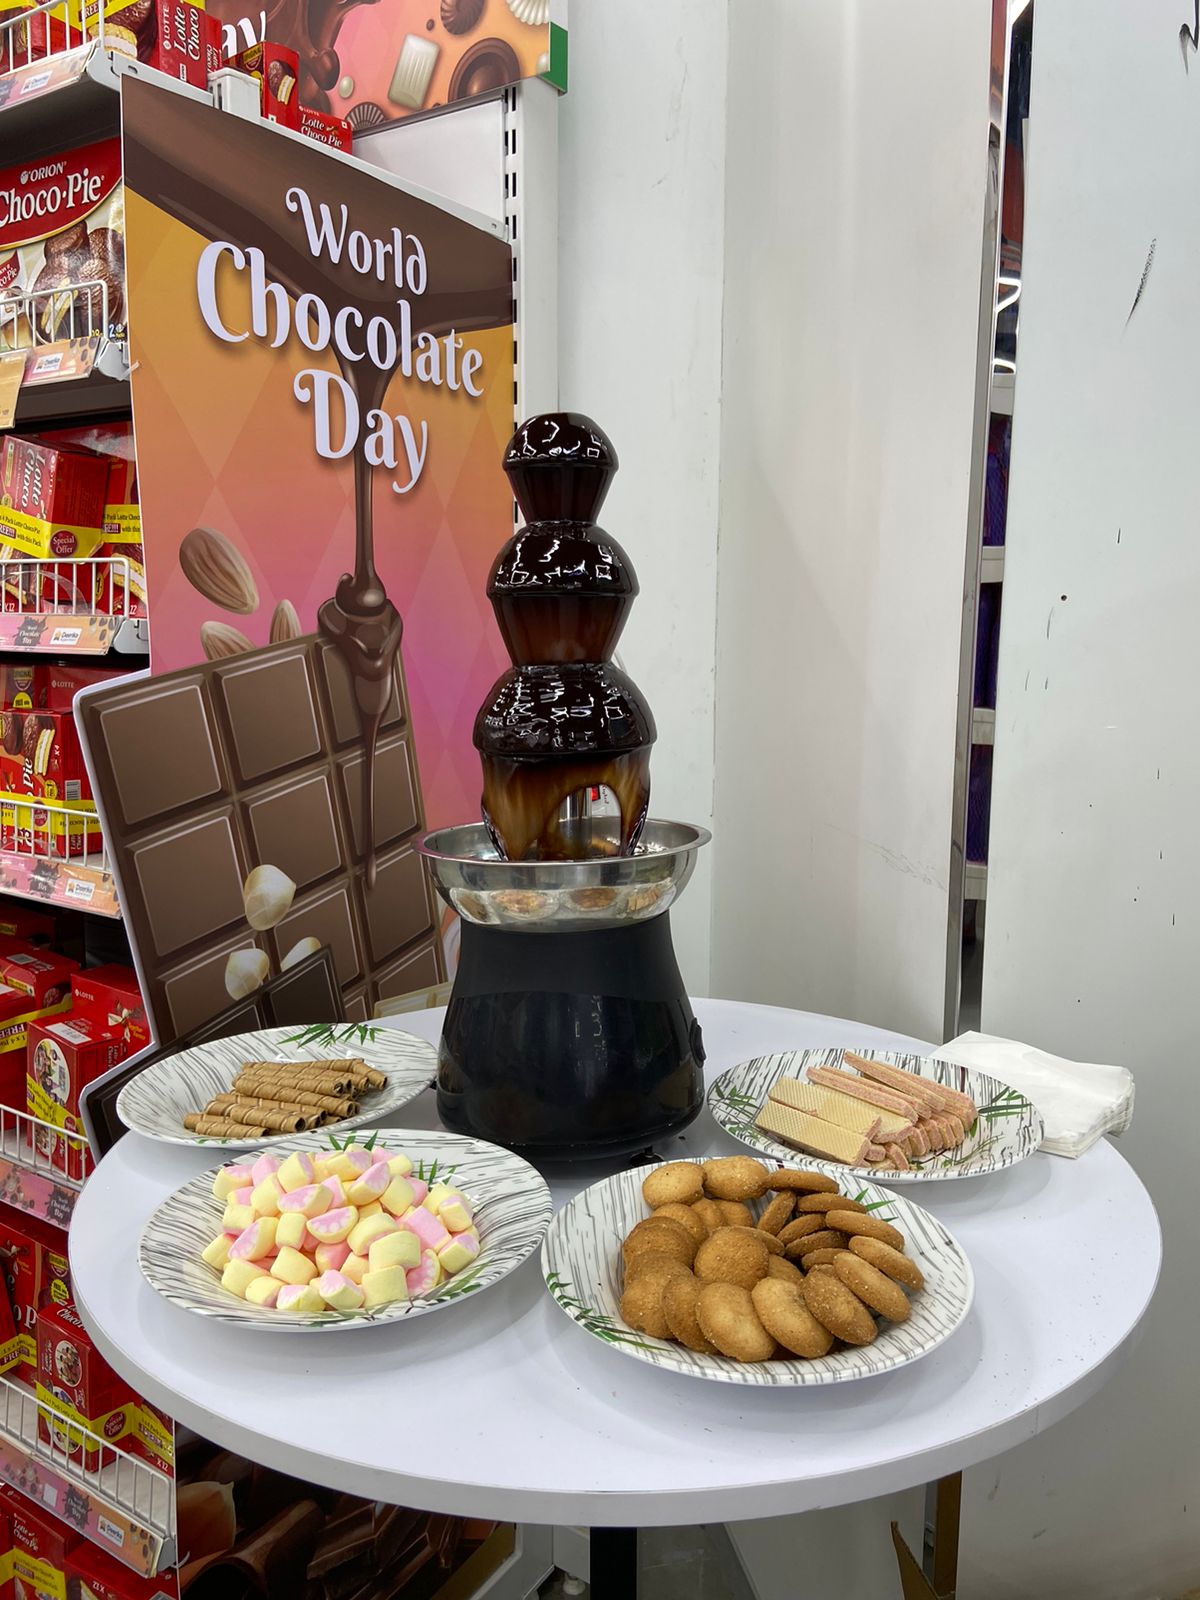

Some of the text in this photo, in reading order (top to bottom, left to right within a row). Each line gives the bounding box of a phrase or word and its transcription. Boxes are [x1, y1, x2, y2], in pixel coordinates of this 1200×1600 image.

[174, 7, 187, 55] Lotte
[188, 8, 201, 60] Choco
[221, 11, 267, 58] ay
[301, 126, 343, 148] Choco Pie
[302, 114, 325, 130] Lotte
[29, 163, 64, 182] ORION
[285, 187, 428, 295] World
[197, 241, 484, 397] Chocolate
[293, 368, 428, 494] Day
[21, 448, 35, 508] Choco
[32, 453, 45, 506] Lotte
[53, 535, 75, 546] Special
[56, 545, 73, 554] Offer
[23, 758, 34, 789] Pie
[14, 1520, 28, 1533] Lotte
